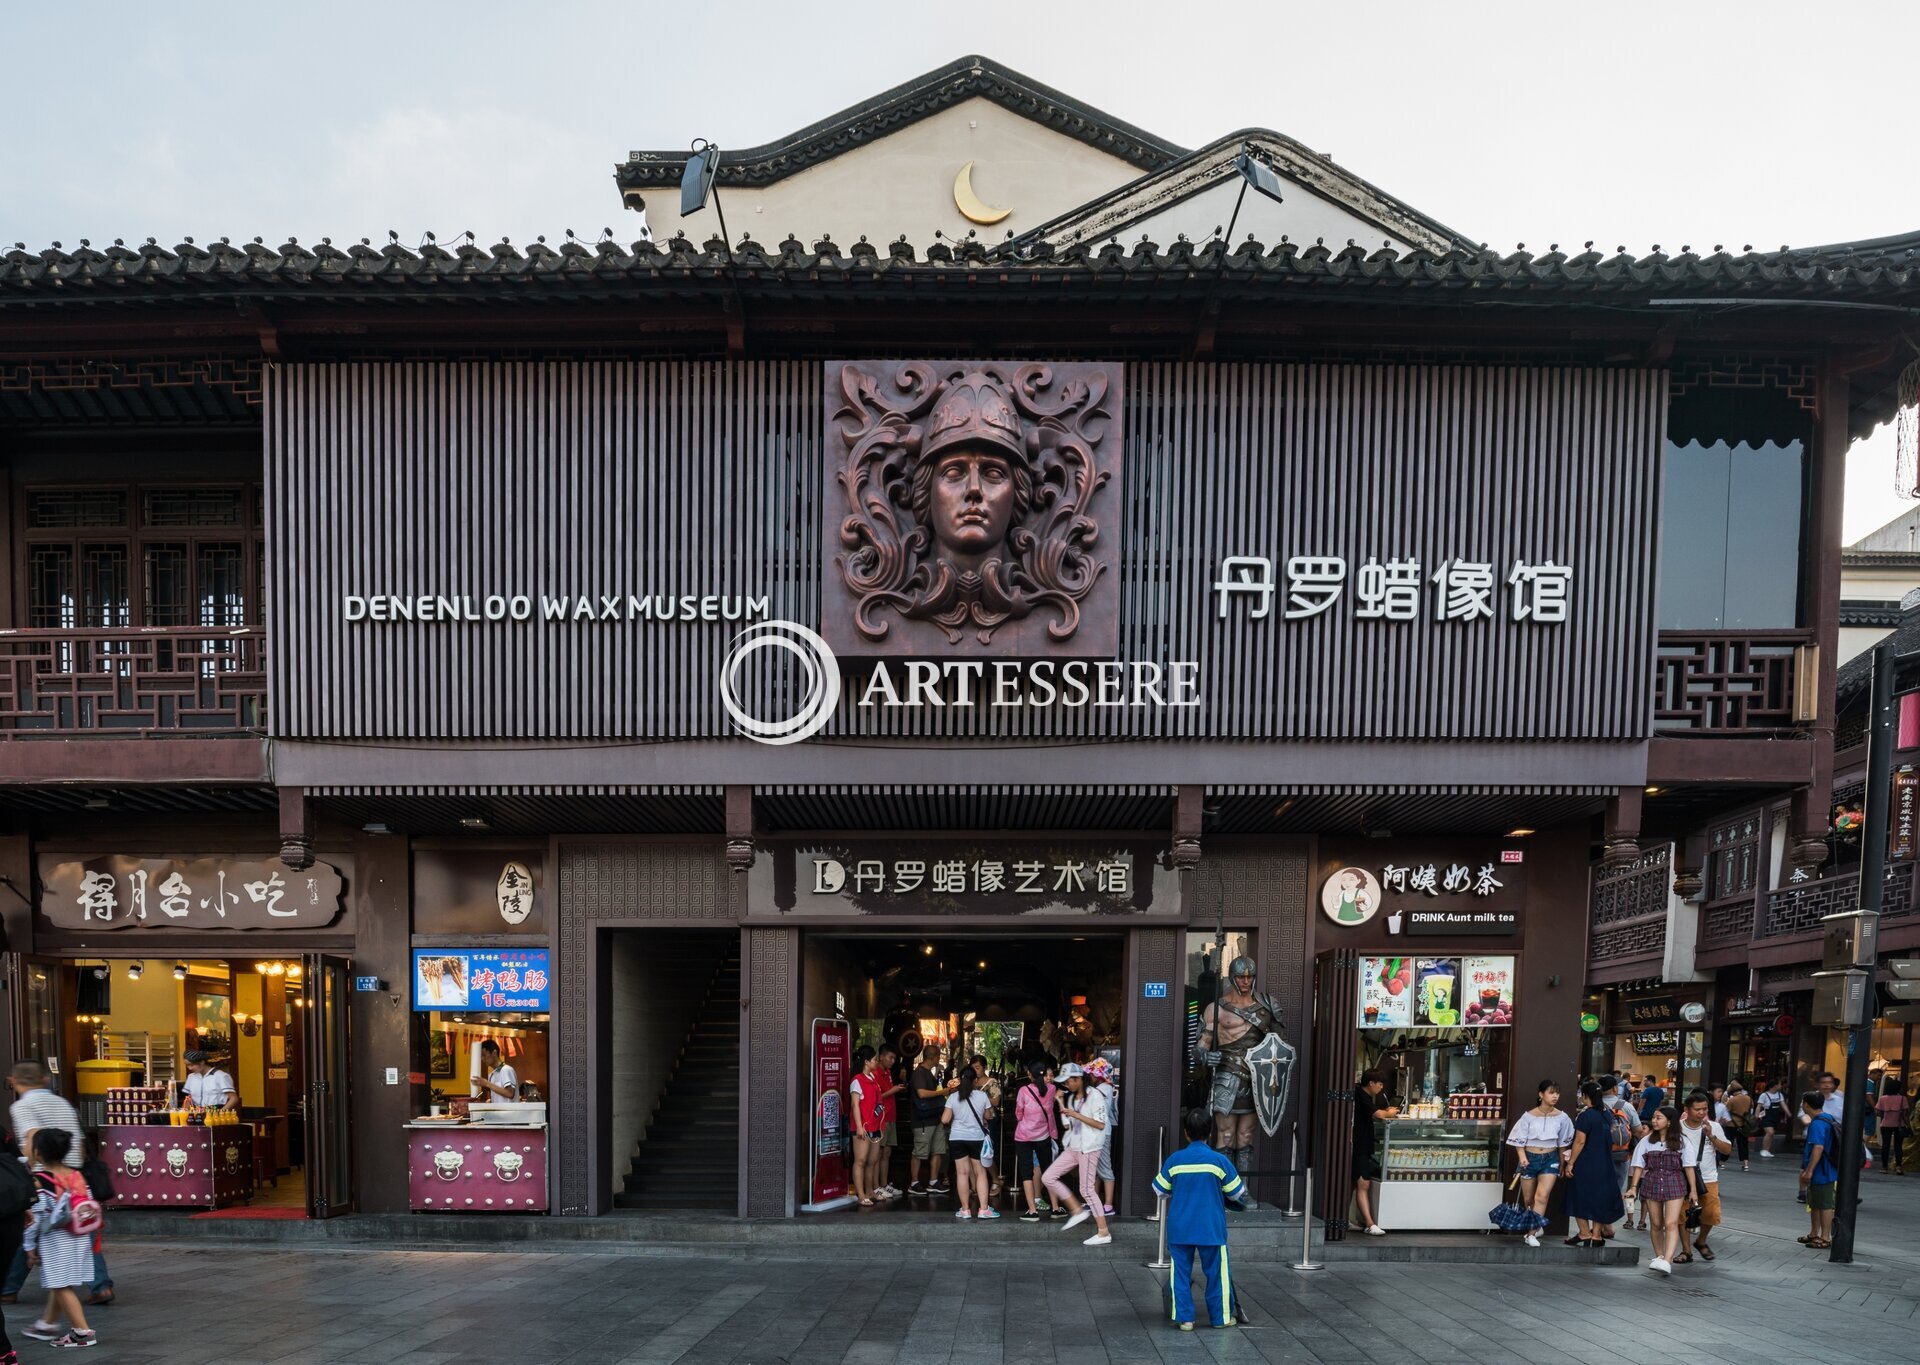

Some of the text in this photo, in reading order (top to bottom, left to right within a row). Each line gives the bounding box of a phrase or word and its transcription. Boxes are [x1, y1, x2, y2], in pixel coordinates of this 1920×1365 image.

[1214, 556, 1573, 624] 丹罗蜡像馆
[344, 595, 769, 621] DENENLOO WAX MUSEUM
[500, 864, 528, 915] 金陵
[853, 860, 1130, 893] 丹罗蜡像艺术馆
[1383, 863, 1503, 896] 阿姨奶茶
[77, 870, 298, 921] 得月台小吃
[1411, 913, 1515, 922] DRINK Aunt milk tea
[471, 968, 548, 992] 烤鸭肠
